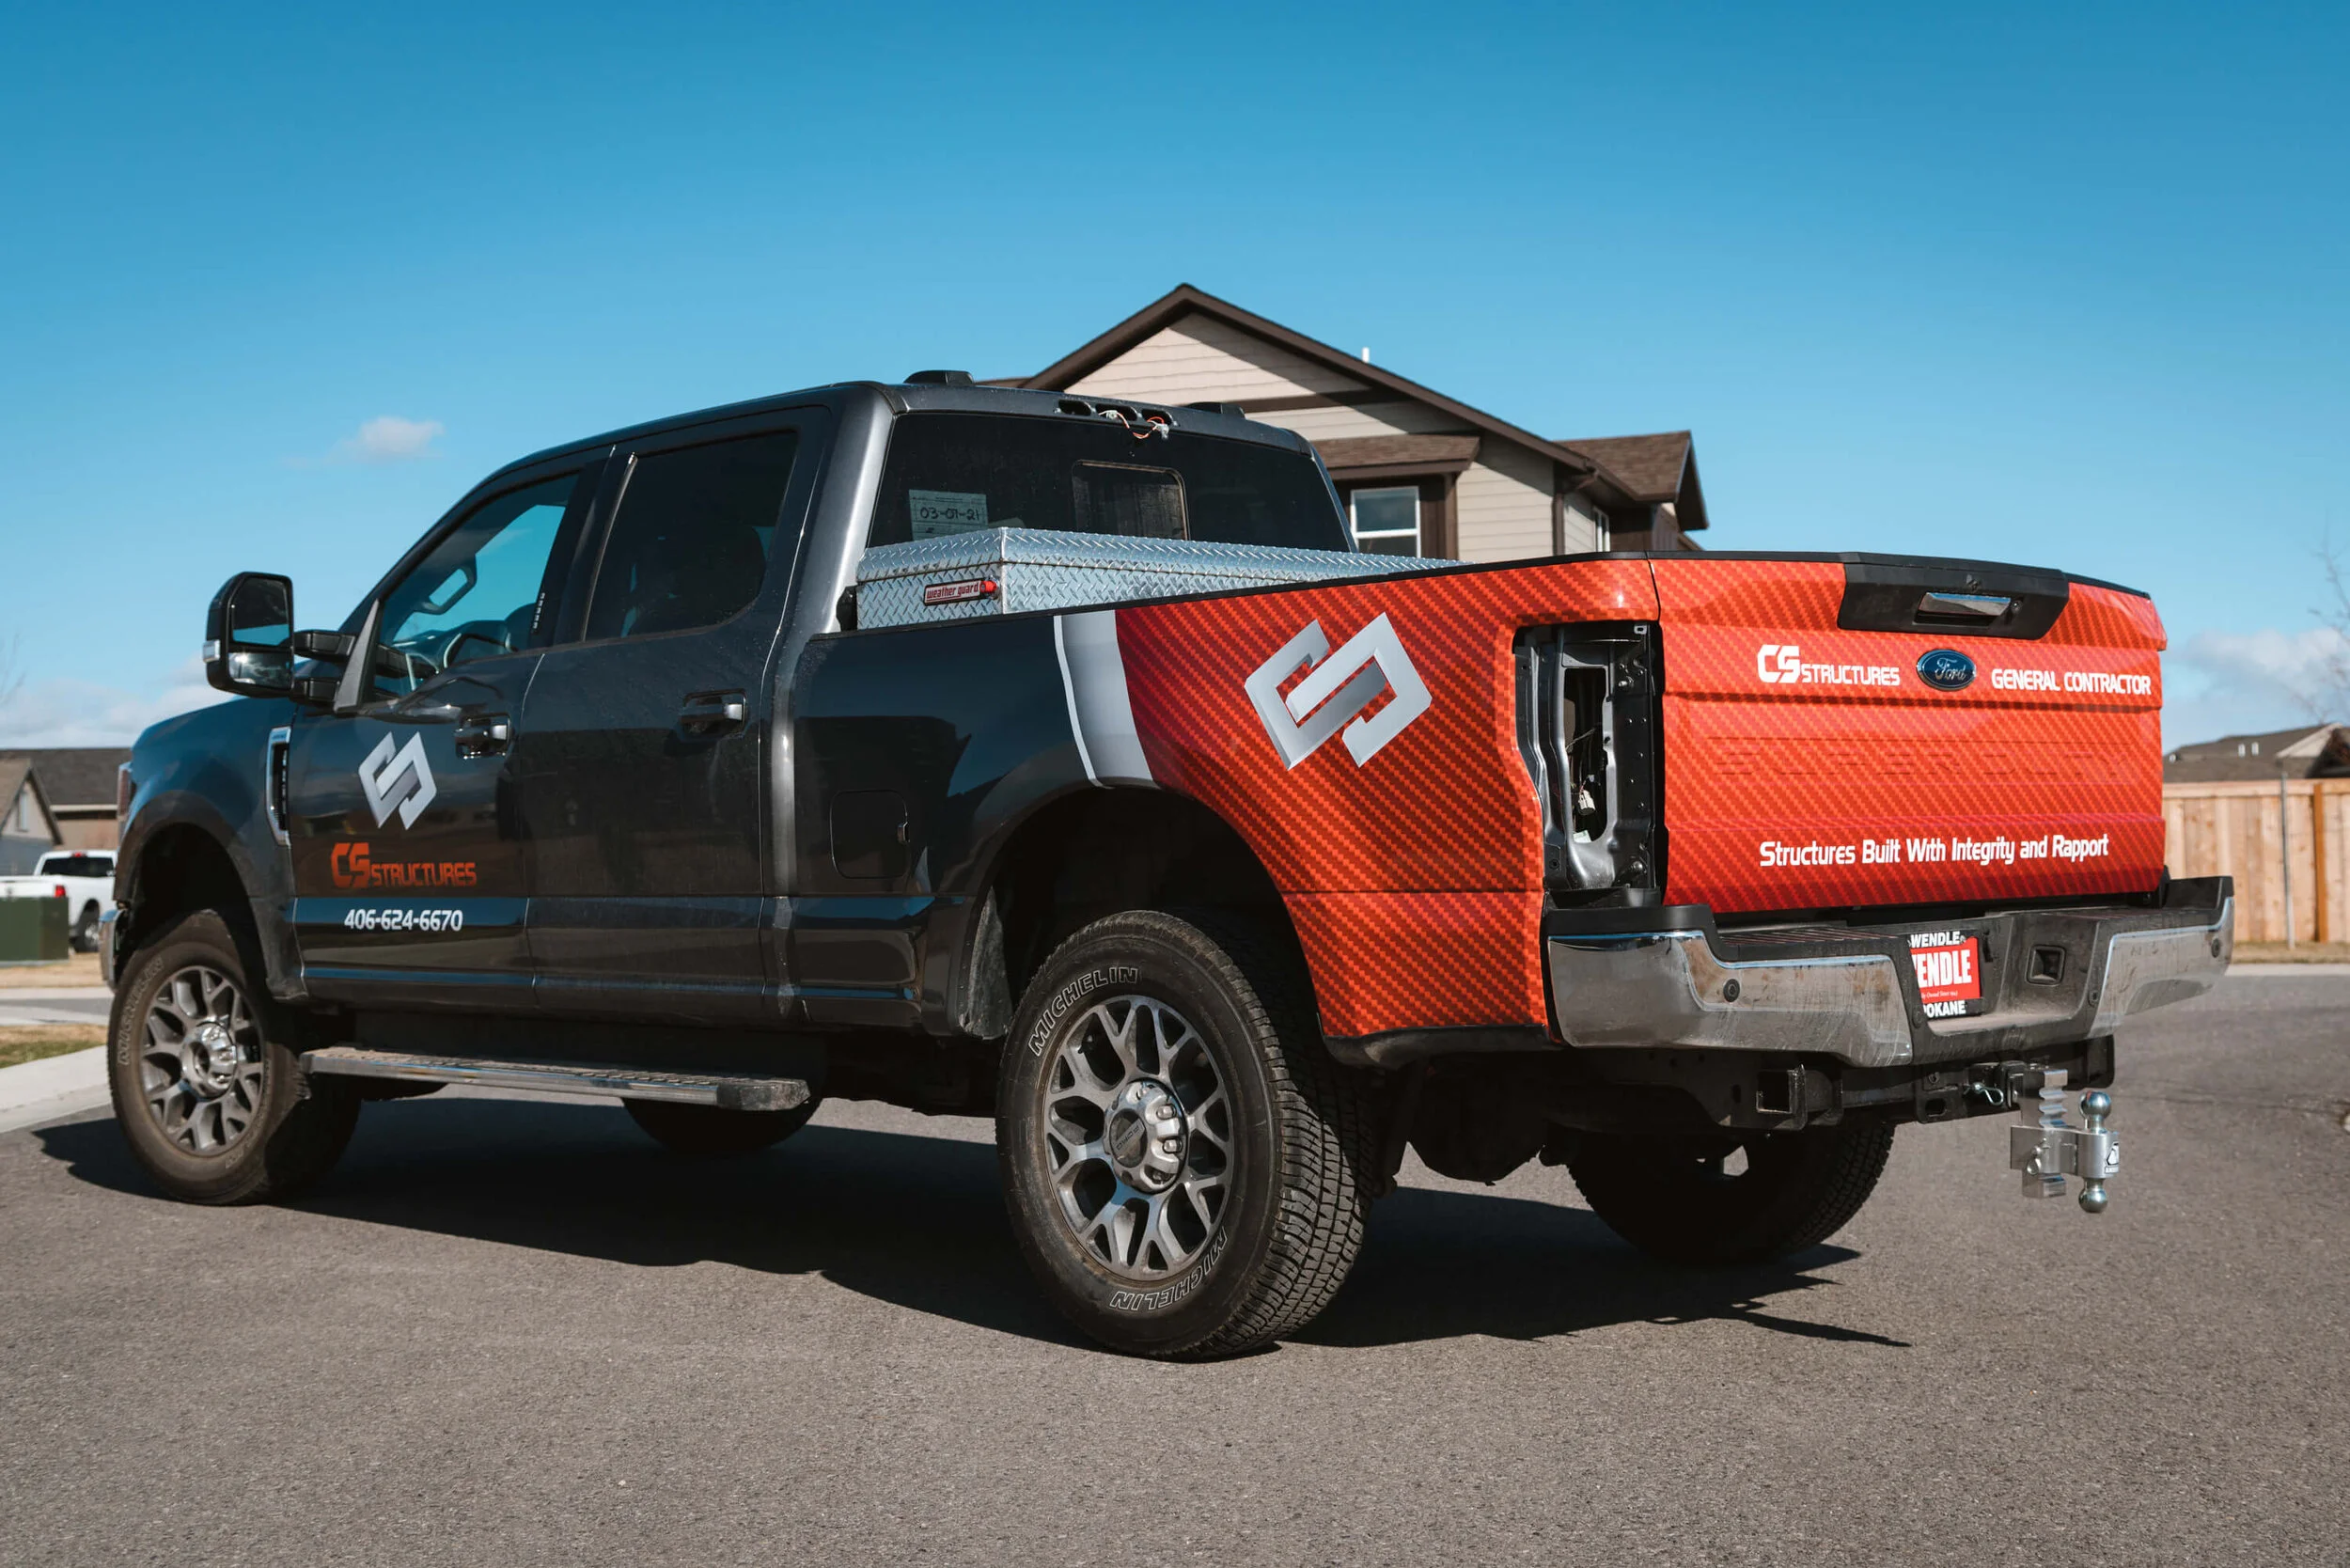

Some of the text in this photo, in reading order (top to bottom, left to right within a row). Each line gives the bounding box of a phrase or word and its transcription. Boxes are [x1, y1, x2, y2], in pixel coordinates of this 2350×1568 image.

[920, 507, 979, 521] 03-01-21
[927, 583, 979, 599] weather guard
[1935, 658, 1966, 682] Ford
[1991, 668, 2152, 695] GENERAL CONTRACTOR
[1760, 834, 2109, 867] Structures Built With Integrity and Rapport
[344, 909, 463, 932] 406-624-6670
[1911, 931, 1961, 949] WENDLE
[1028, 966, 1138, 1057] MICHELIN
[1109, 1227, 1228, 1311] MICHELIN
